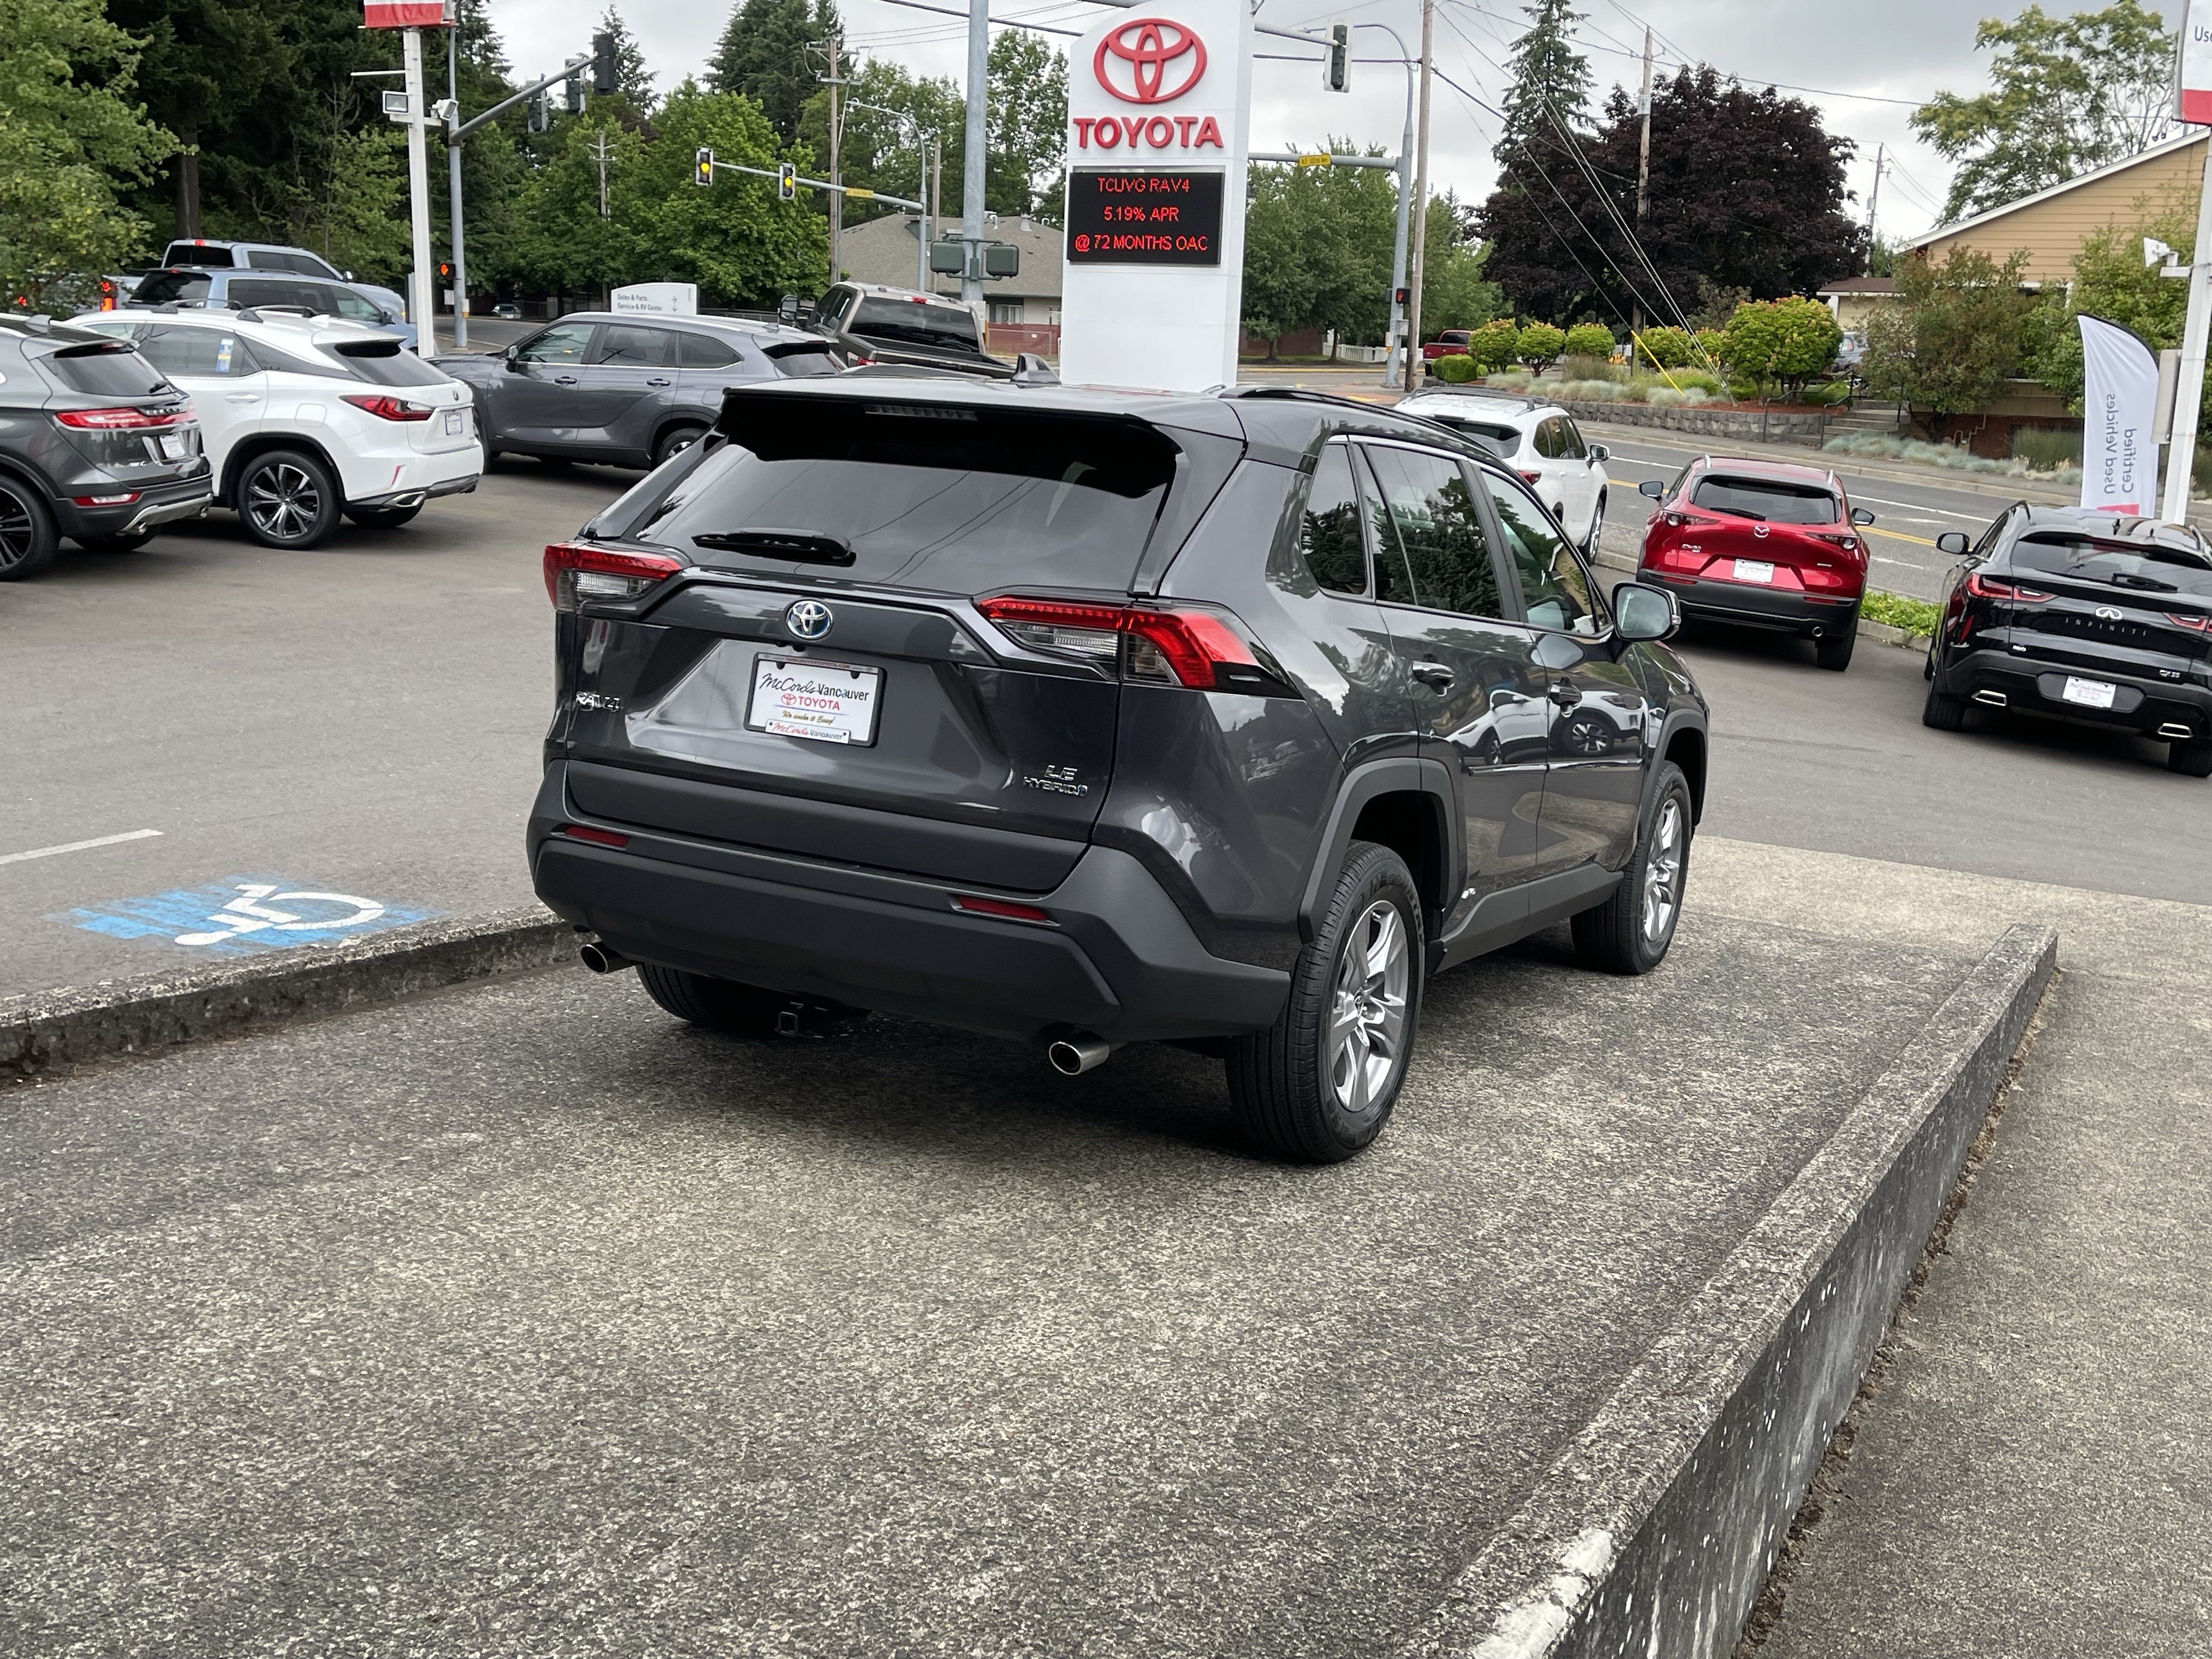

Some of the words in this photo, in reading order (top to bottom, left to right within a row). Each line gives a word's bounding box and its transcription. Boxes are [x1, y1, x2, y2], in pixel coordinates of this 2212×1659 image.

[1073, 116, 1224, 149] TOYOTA
[1097, 177, 1146, 193] TCUVG
[1150, 178, 1190, 193] RAV4
[1104, 206, 1146, 222] 5.19%
[1150, 207, 1180, 222] APR
[1075, 234, 1090, 252] @
[1093, 235, 1110, 250] 72
[1113, 235, 1172, 251] MONTHS
[1176, 236, 1208, 251] OAC
[818, 684, 870, 701] Vancouver
[798, 696, 840, 710] TOYOTA
[810, 730, 843, 740] Vancouver
[1044, 764, 1078, 781] LE
[1023, 776, 1088, 797] HYBRID
